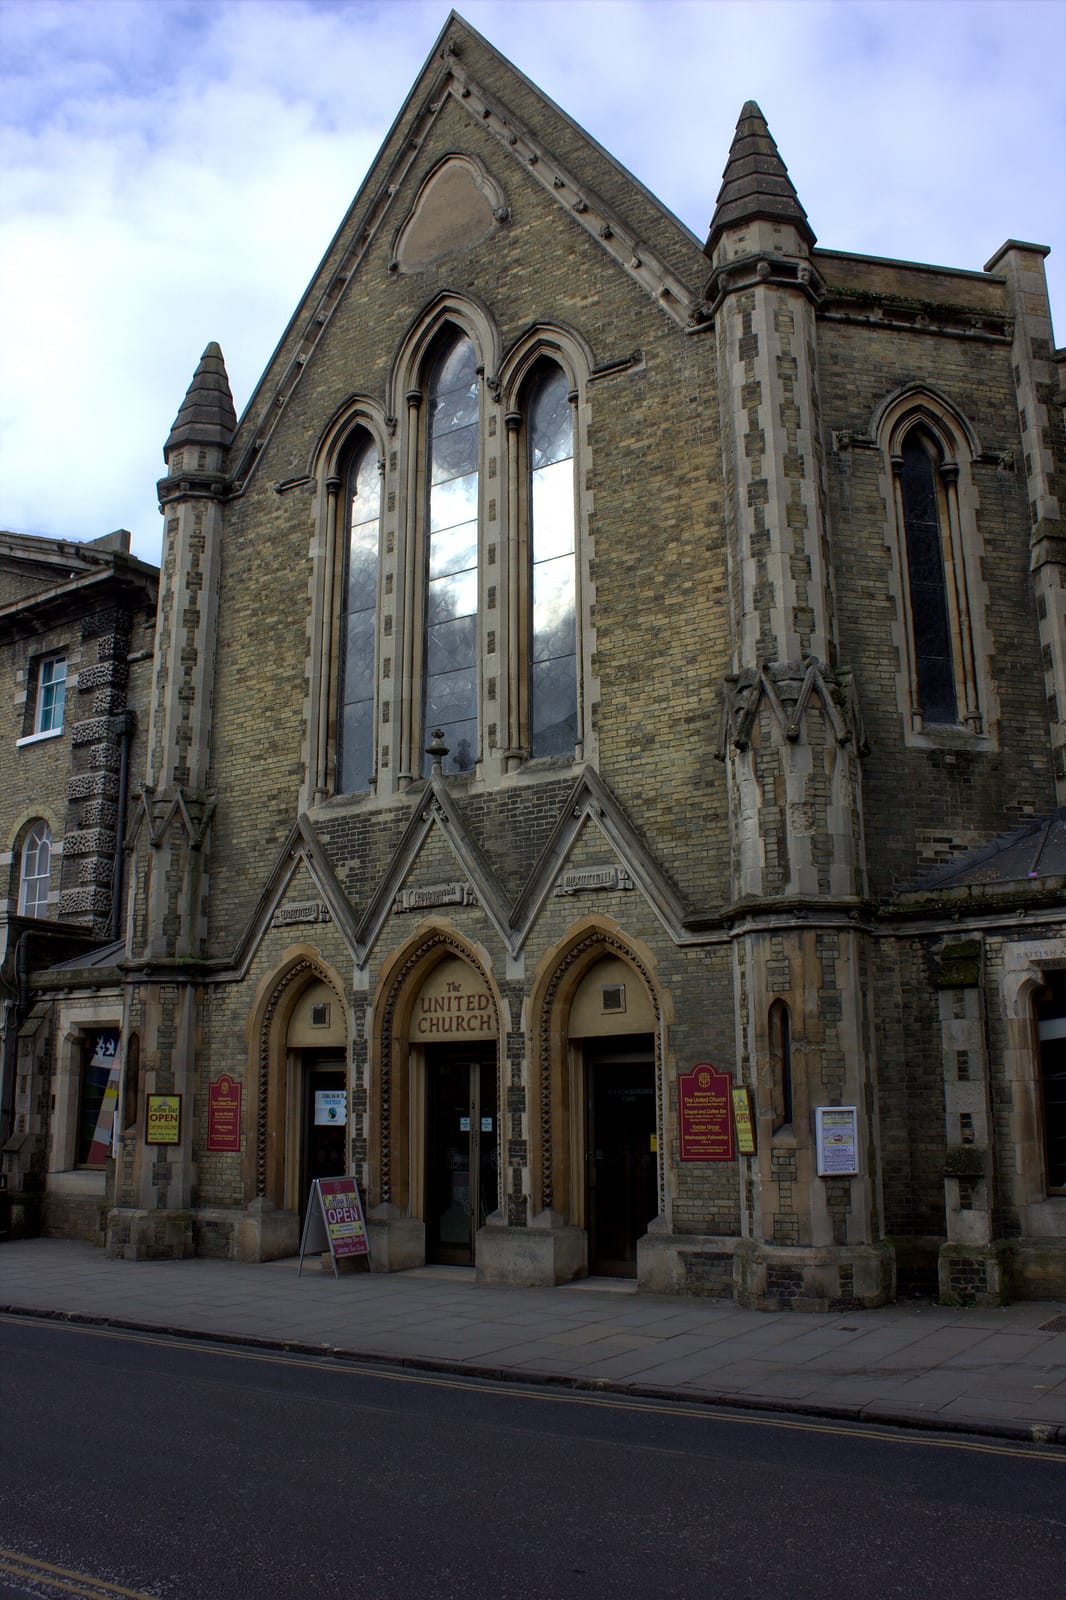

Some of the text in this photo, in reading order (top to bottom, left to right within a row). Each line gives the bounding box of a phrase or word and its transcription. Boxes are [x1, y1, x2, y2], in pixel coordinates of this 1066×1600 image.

[446, 981, 462, 993] The
[421, 993, 490, 1013] UNITED
[418, 1014, 491, 1033] CHURCH
[150, 1104, 178, 1113] Coffee Bar
[150, 1114, 178, 1122] OPEN
[736, 1112, 751, 1124] OPEN
[324, 1193, 359, 1209] Coffee Bar
[328, 1207, 359, 1224] OPEN
